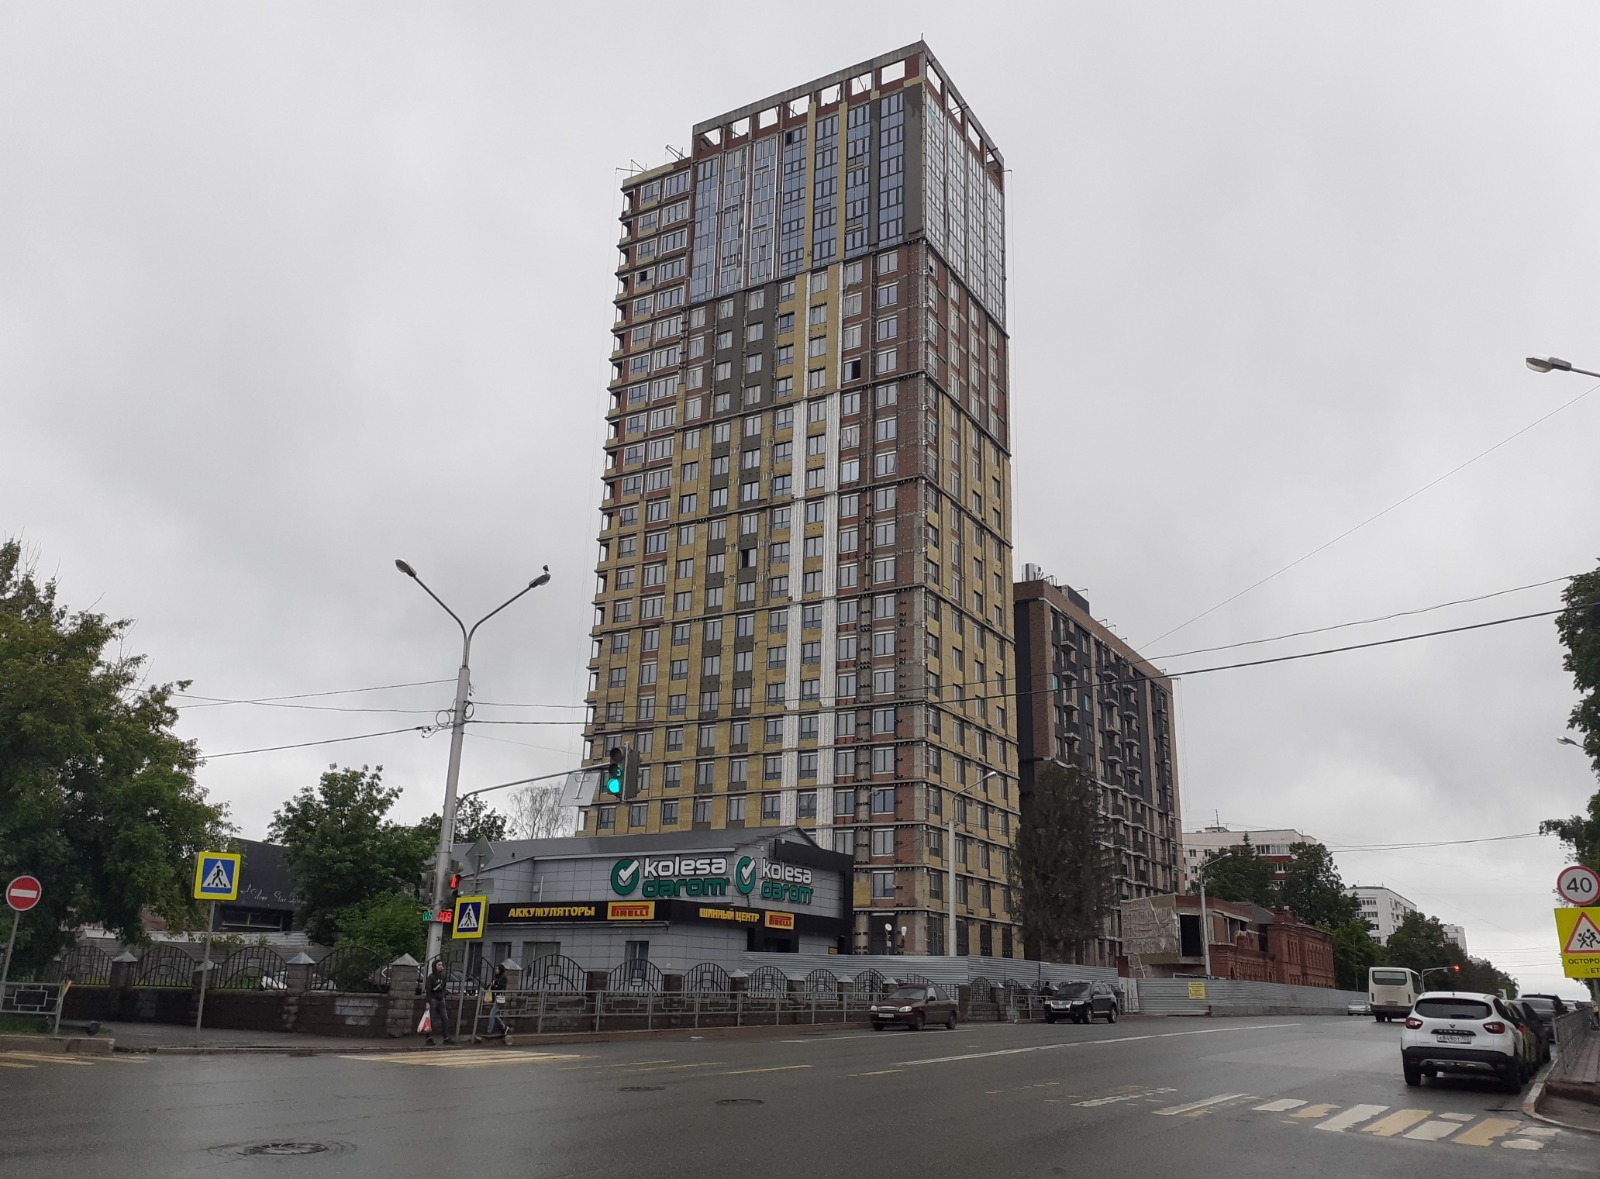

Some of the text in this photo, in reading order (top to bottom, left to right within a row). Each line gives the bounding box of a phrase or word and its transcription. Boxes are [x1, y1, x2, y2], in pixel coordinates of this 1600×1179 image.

[644, 855, 728, 877] kolesa
[761, 857, 812, 884] kolesa
[642, 877, 729, 897] darom
[760, 879, 813, 904] darom
[1566, 877, 1592, 893] 40
[508, 906, 595, 918] АККУМУЛЯТОРЫ
[611, 905, 649, 917] PIRELLI
[699, 907, 759, 923] ШИННЫЙ ЦЕНТР
